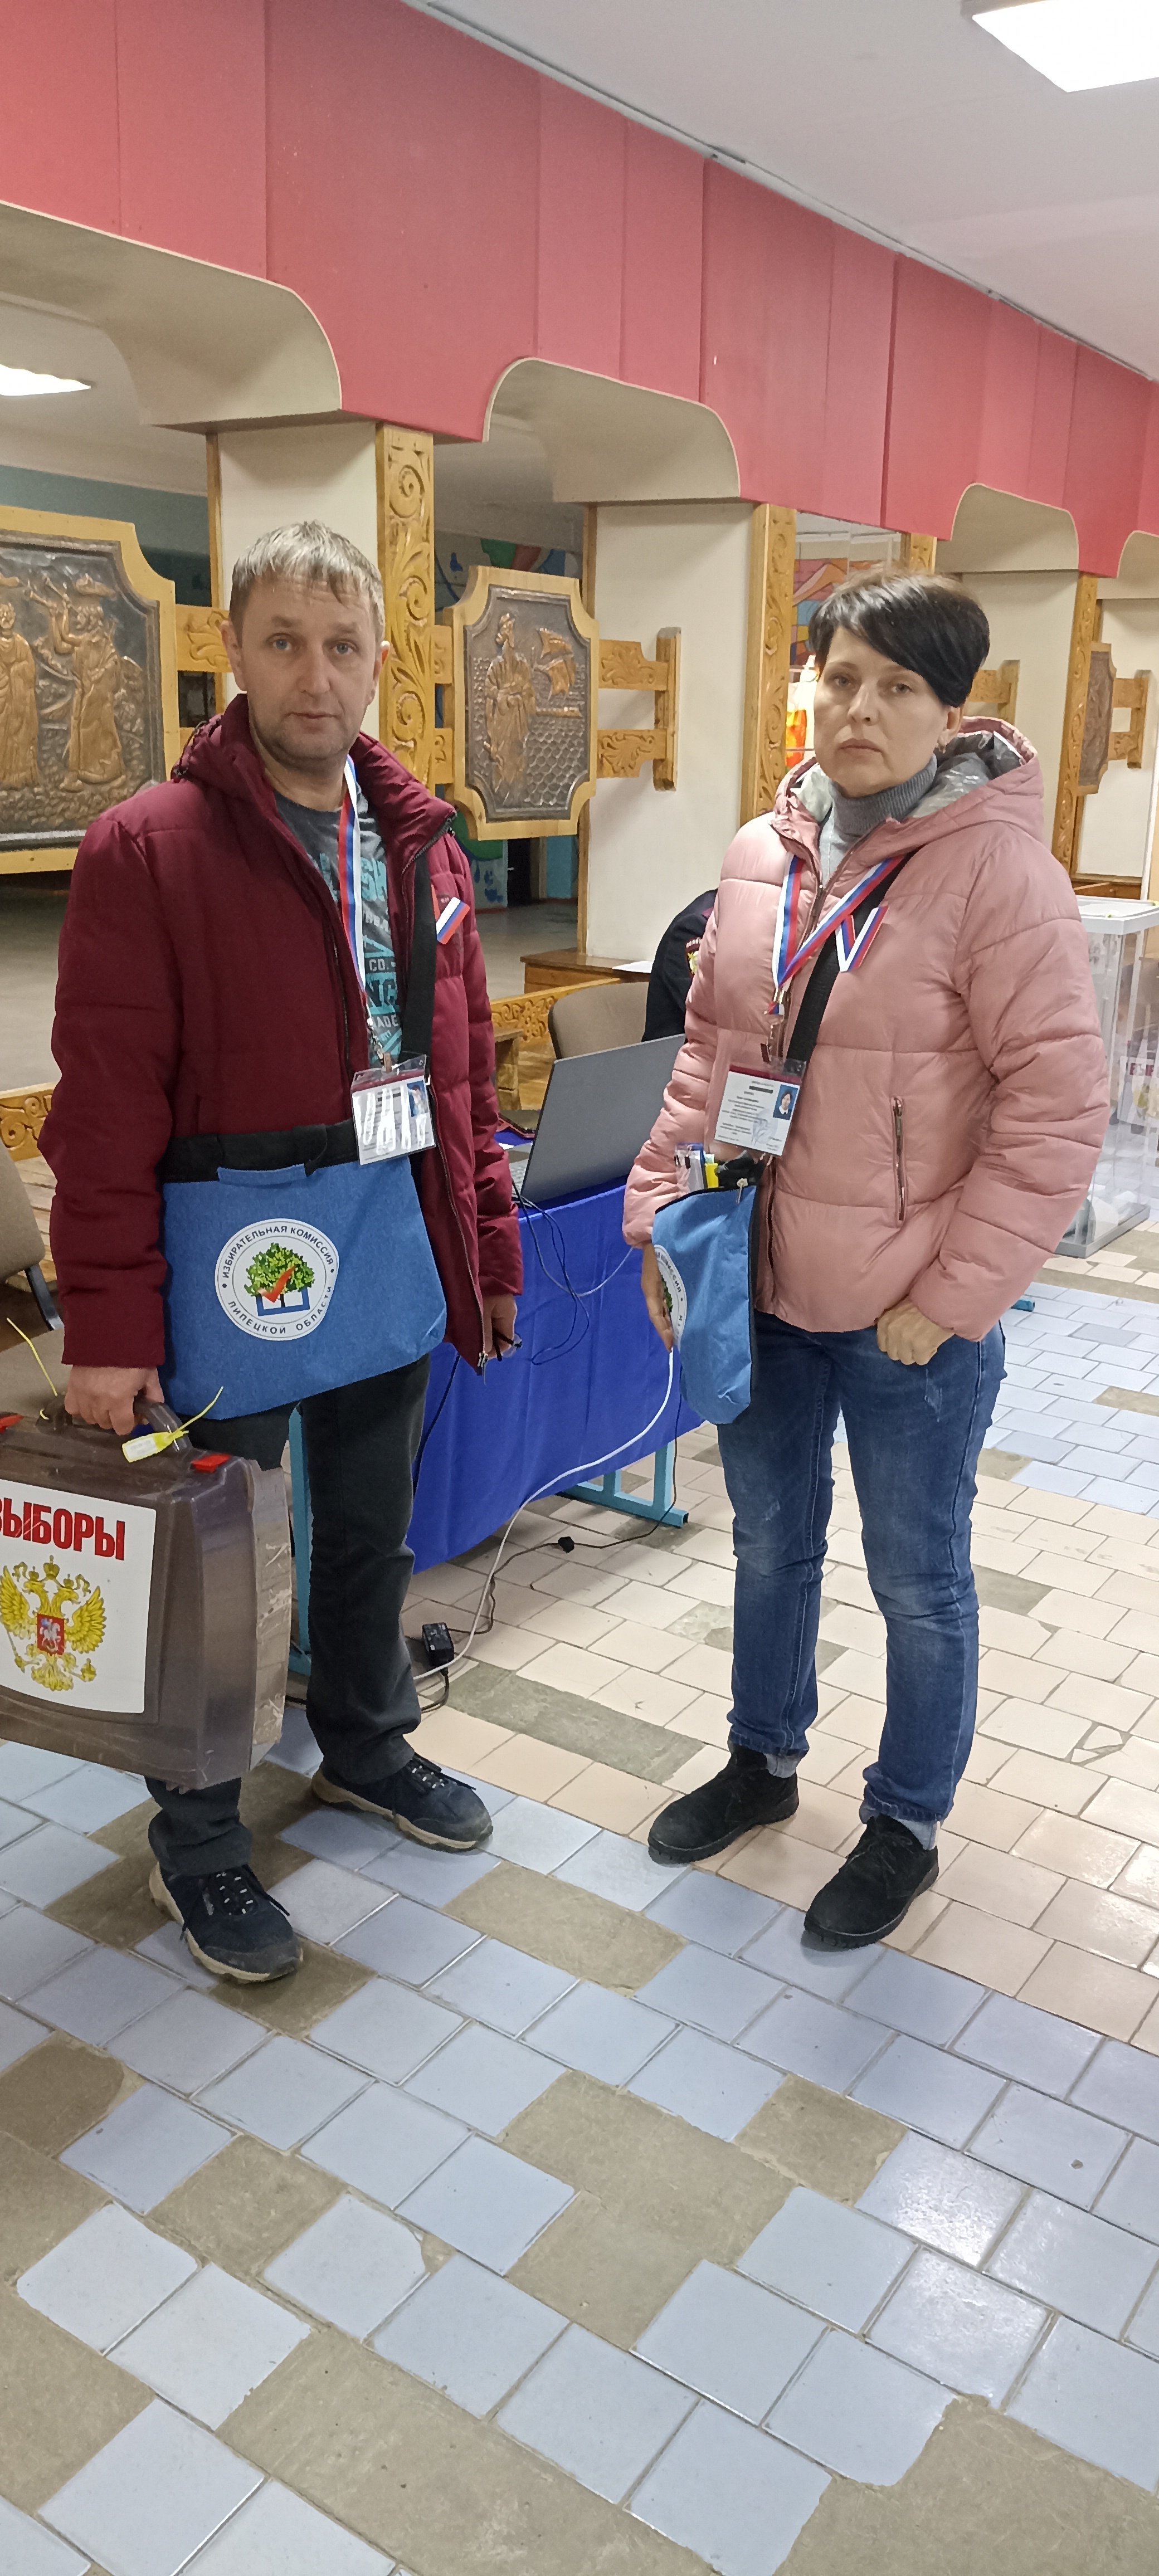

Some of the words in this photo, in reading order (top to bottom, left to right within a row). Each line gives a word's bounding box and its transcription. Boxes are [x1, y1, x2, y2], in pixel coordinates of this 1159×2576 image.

[373, 1013, 399, 1028] ADE
[223, 1226, 288, 1279] ИЗБИРАТЕЛЬНАЯ
[290, 1227, 334, 1265] КОМИССИЯ
[228, 1301, 286, 1334] ЛИПЕЦКОЙ
[296, 1286, 332, 1331] ОБЛАСТИ
[0, 1497, 125, 1561] ЫБОРЫ
